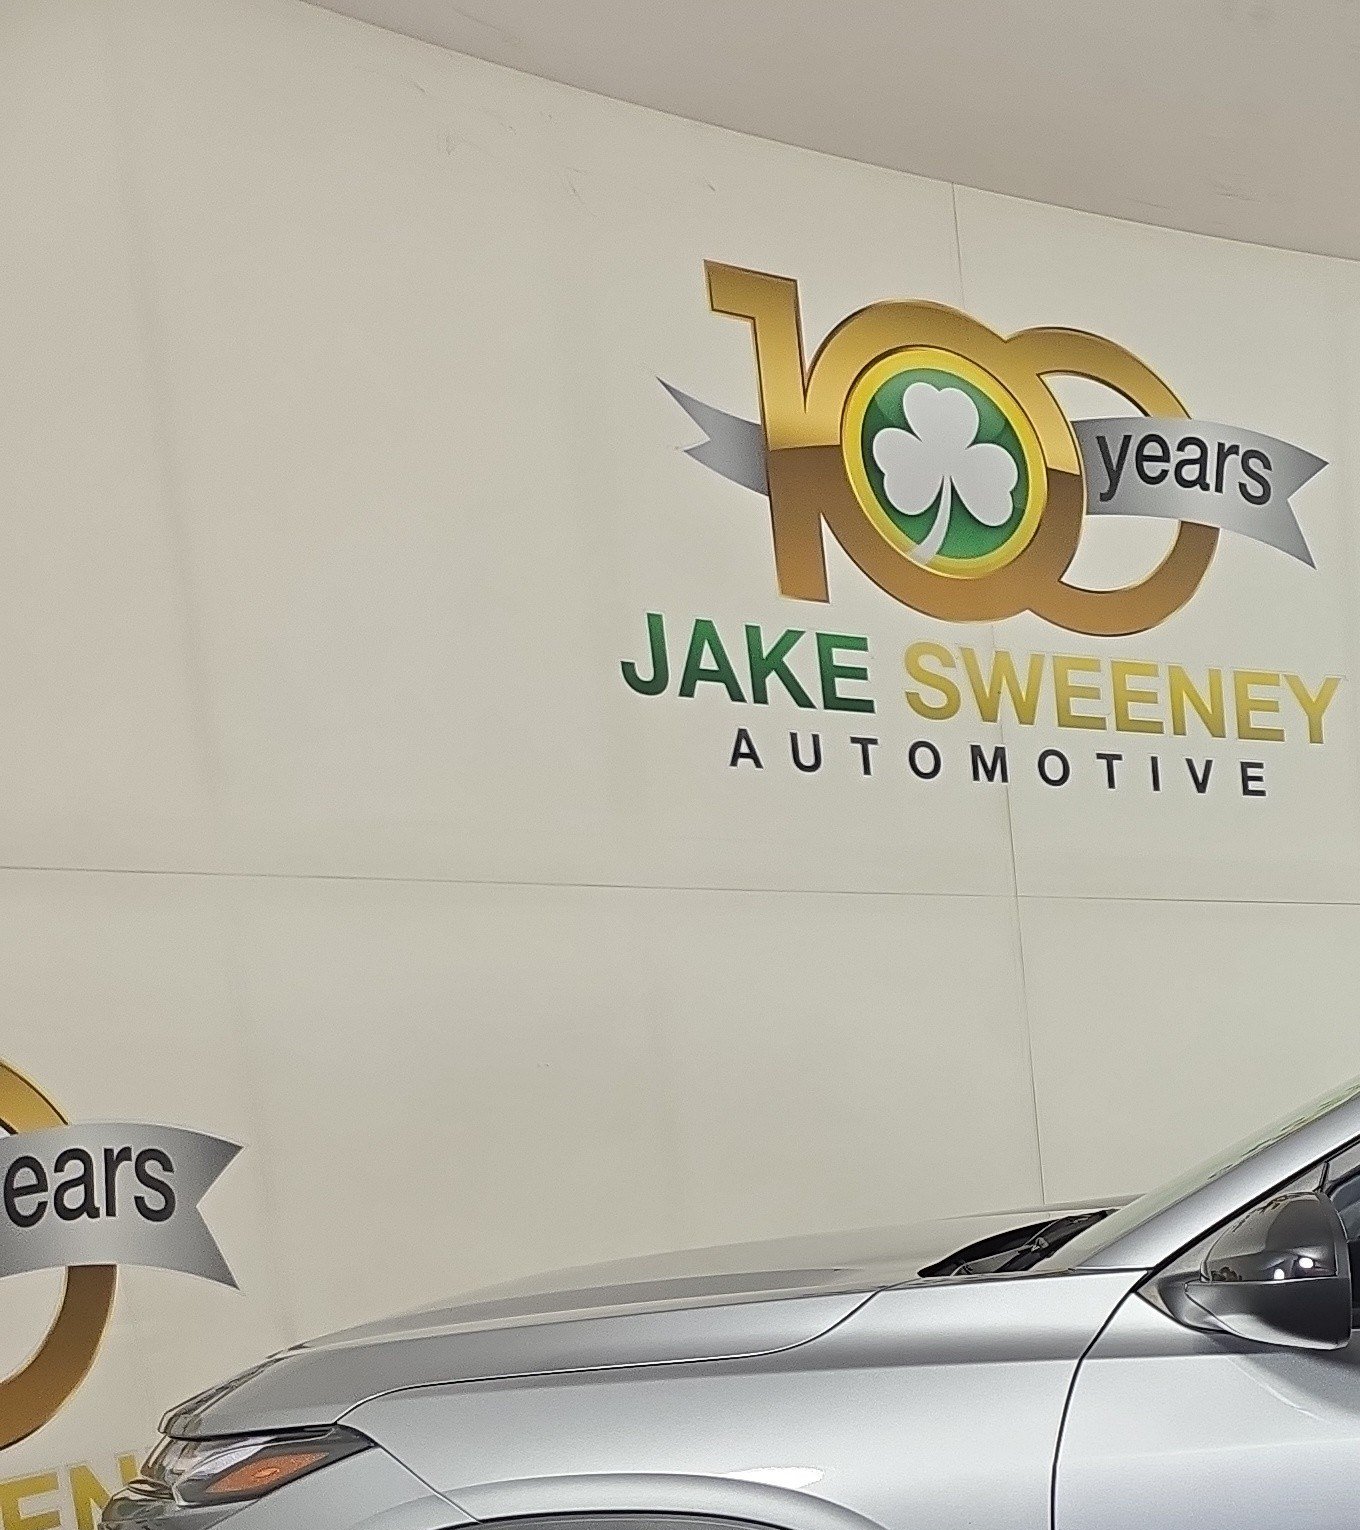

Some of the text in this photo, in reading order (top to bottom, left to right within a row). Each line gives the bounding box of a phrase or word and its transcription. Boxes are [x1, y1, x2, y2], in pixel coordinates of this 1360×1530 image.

[704, 259, 1221, 636] 100
[1096, 430, 1275, 506] years
[620, 612, 1343, 746] JAKE SWEENEY
[729, 727, 1268, 797] AUTOMOTIVE
[1, 1145, 176, 1229] ears
